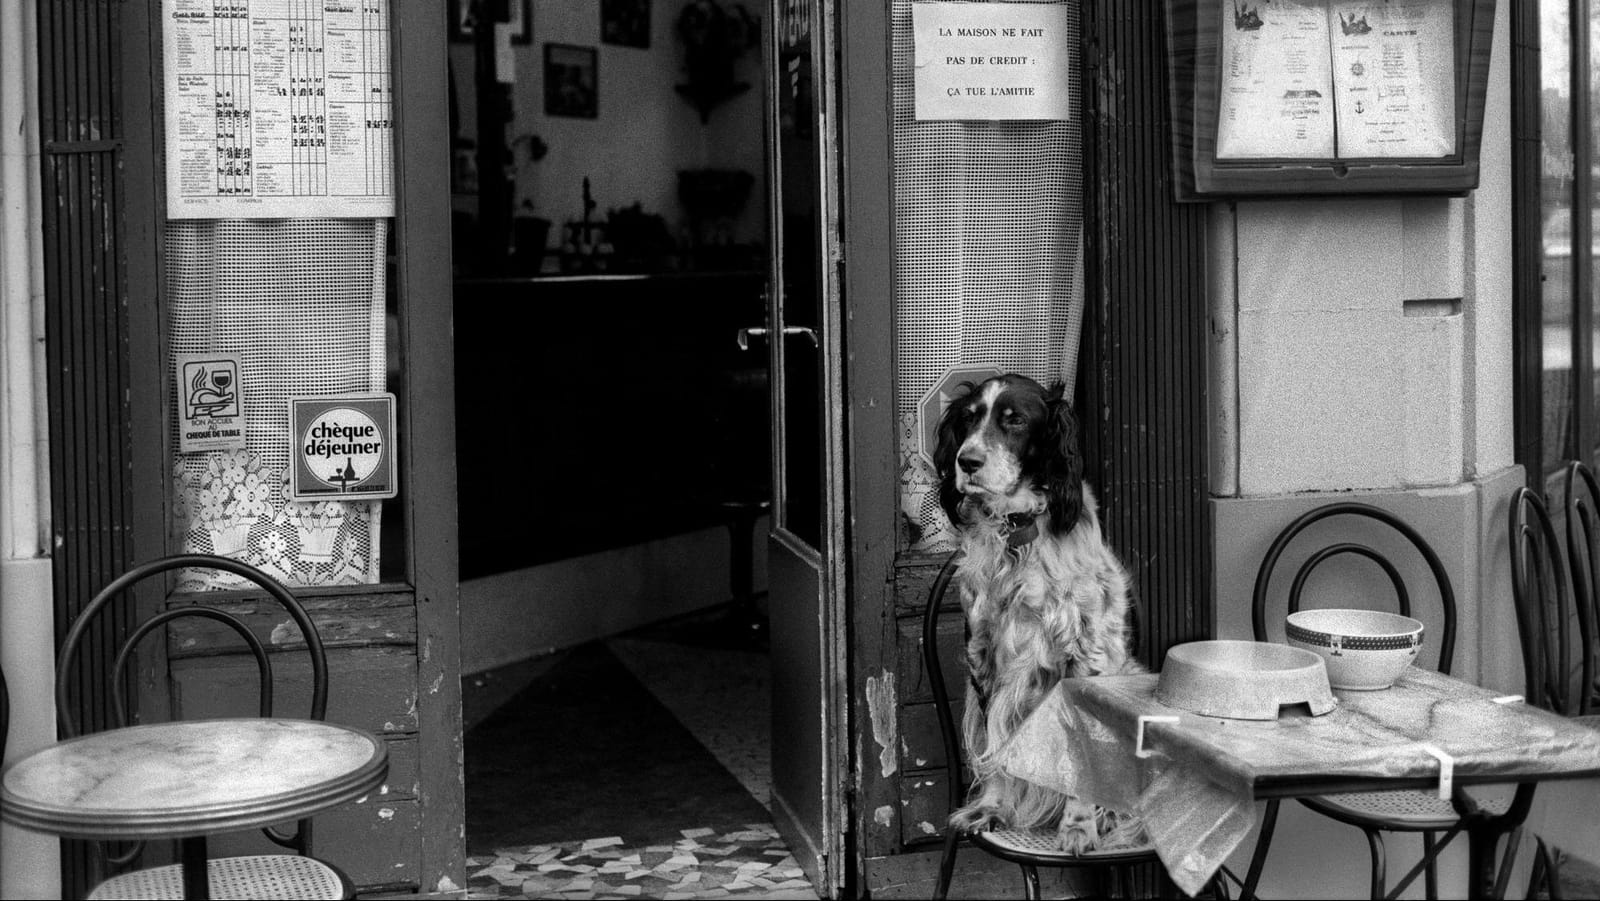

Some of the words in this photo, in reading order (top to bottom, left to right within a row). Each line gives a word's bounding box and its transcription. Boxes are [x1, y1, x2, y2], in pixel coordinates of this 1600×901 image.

[939, 28, 952, 37] LA
[957, 28, 997, 37] MAISON
[1002, 28, 1016, 37] NE
[1021, 28, 1044, 37] FAIT
[946, 56, 966, 65] PAS
[970, 56, 985, 65] DE
[989, 56, 1028, 65] CREDIT
[946, 87, 961, 97] ÇA
[965, 87, 986, 96] TUE
[991, 87, 1035, 96] L'AMITIE
[212, 430, 220, 438] DE
[220, 429, 241, 438] TABLE
[311, 421, 374, 442] chèque
[305, 438, 381, 459] déjeuner
